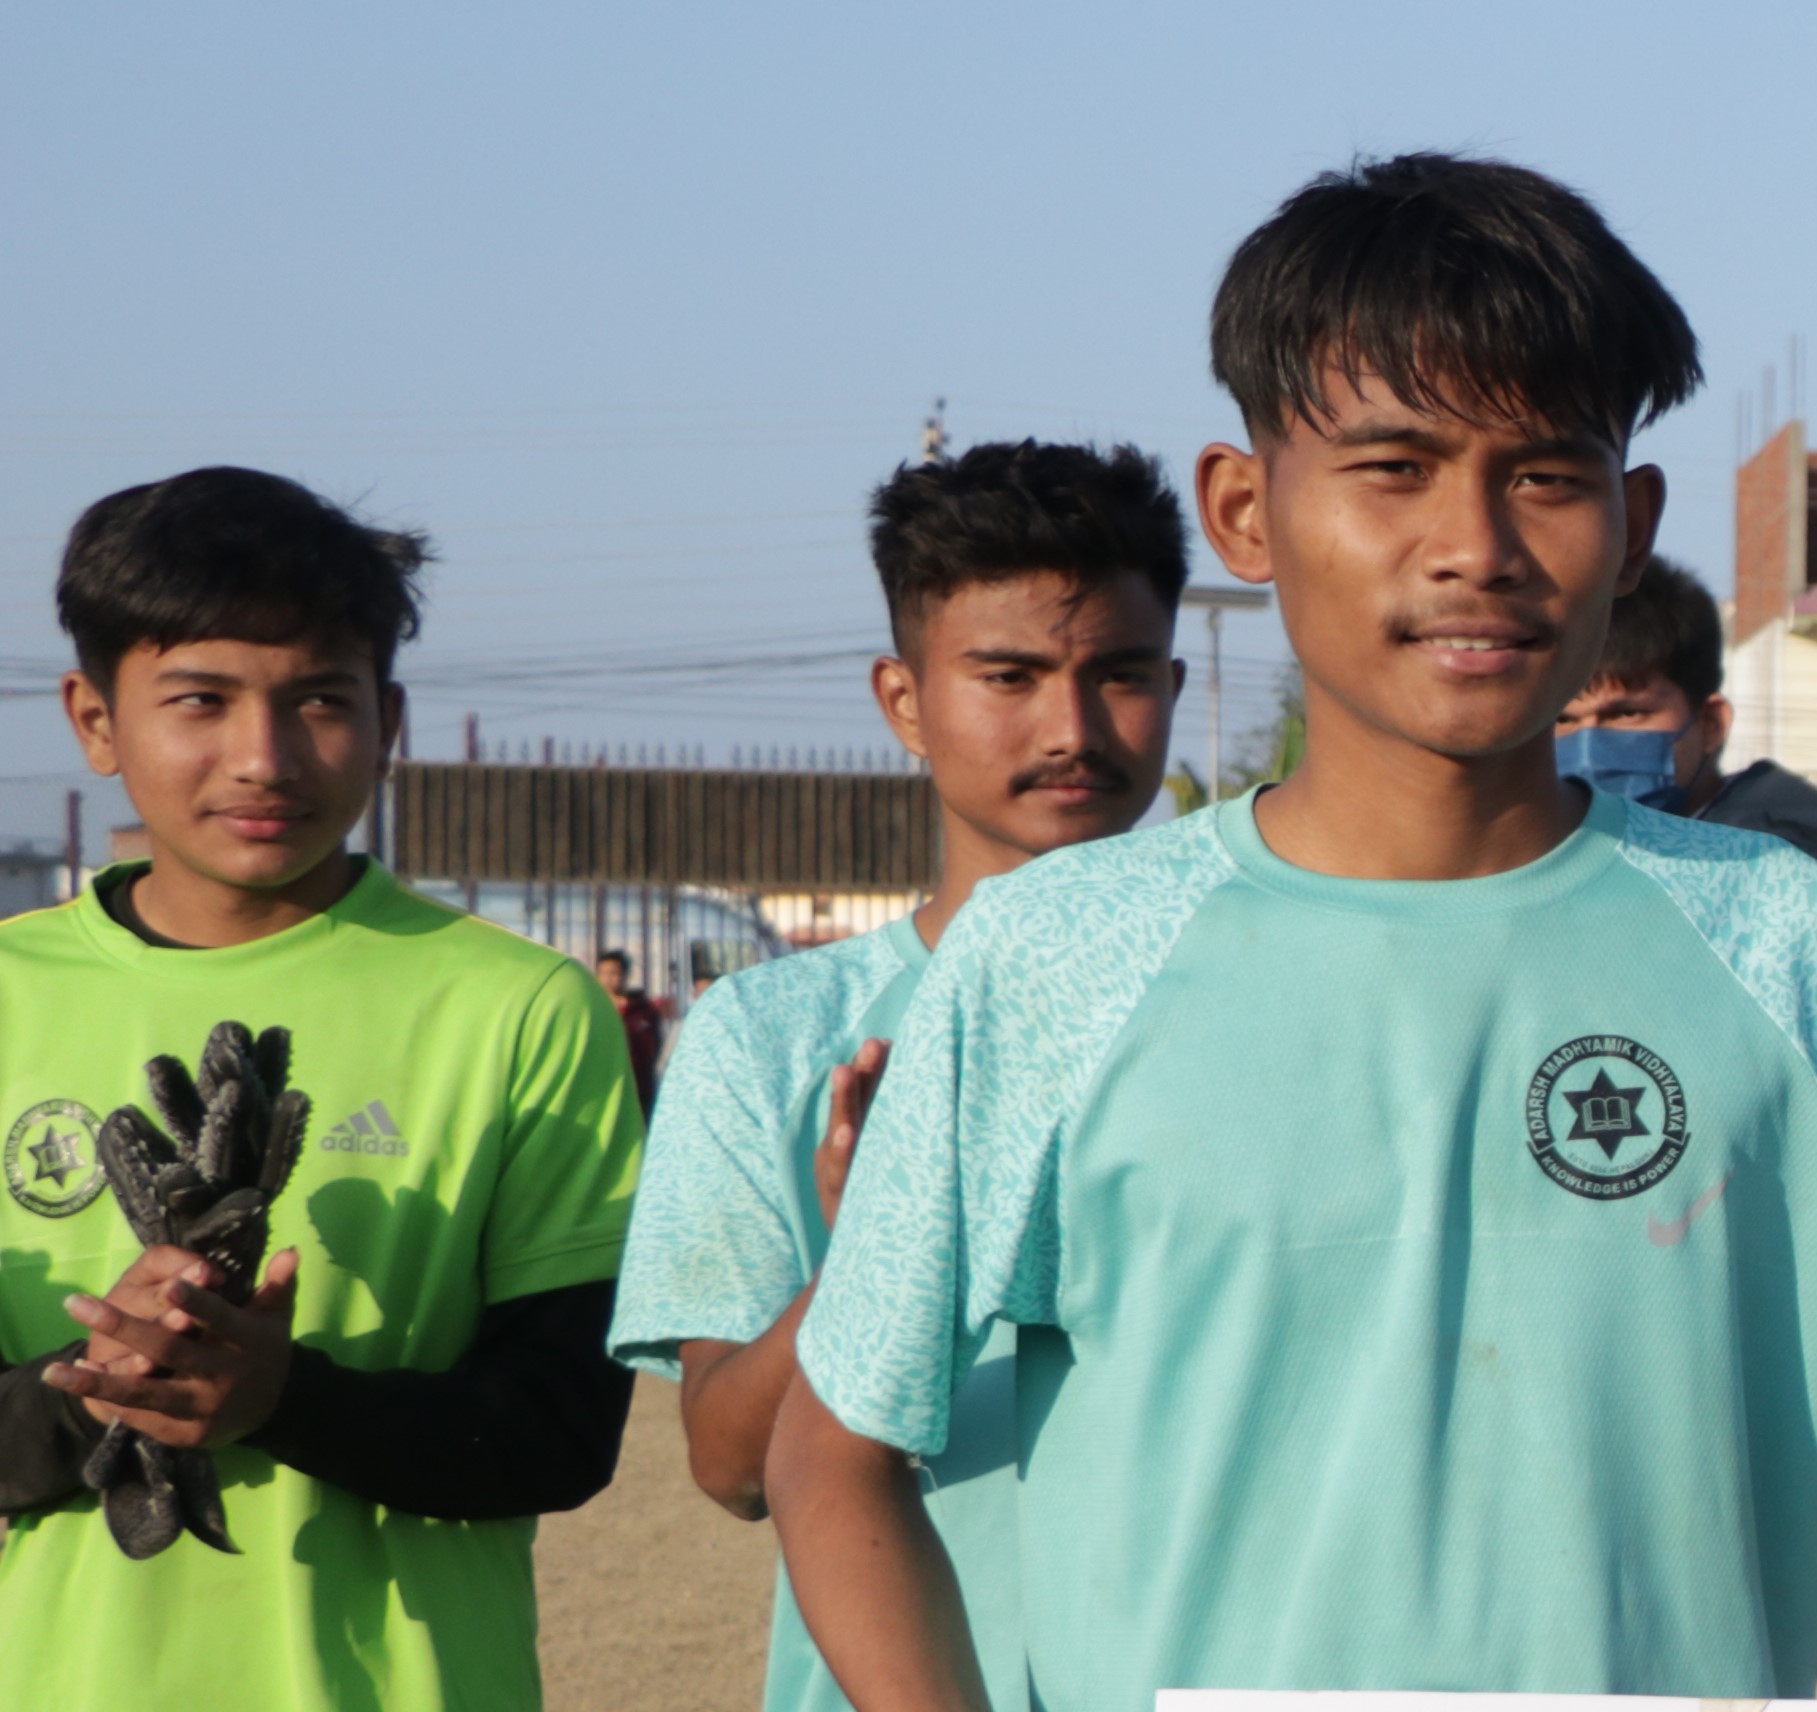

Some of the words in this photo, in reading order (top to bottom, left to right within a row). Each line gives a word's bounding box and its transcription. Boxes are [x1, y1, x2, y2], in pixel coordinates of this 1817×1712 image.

[1528, 1077, 1551, 1141] ADARSH
[1542, 1036, 1634, 1077] MADHYAMIK
[1634, 1048, 1685, 1133] VIDHYALAYA
[319, 1133, 410, 1157] adidas
[1541, 1154, 1621, 1194] KNOWLEDGE
[1623, 1179, 1639, 1192] IS
[1638, 1147, 1681, 1186] POWER
